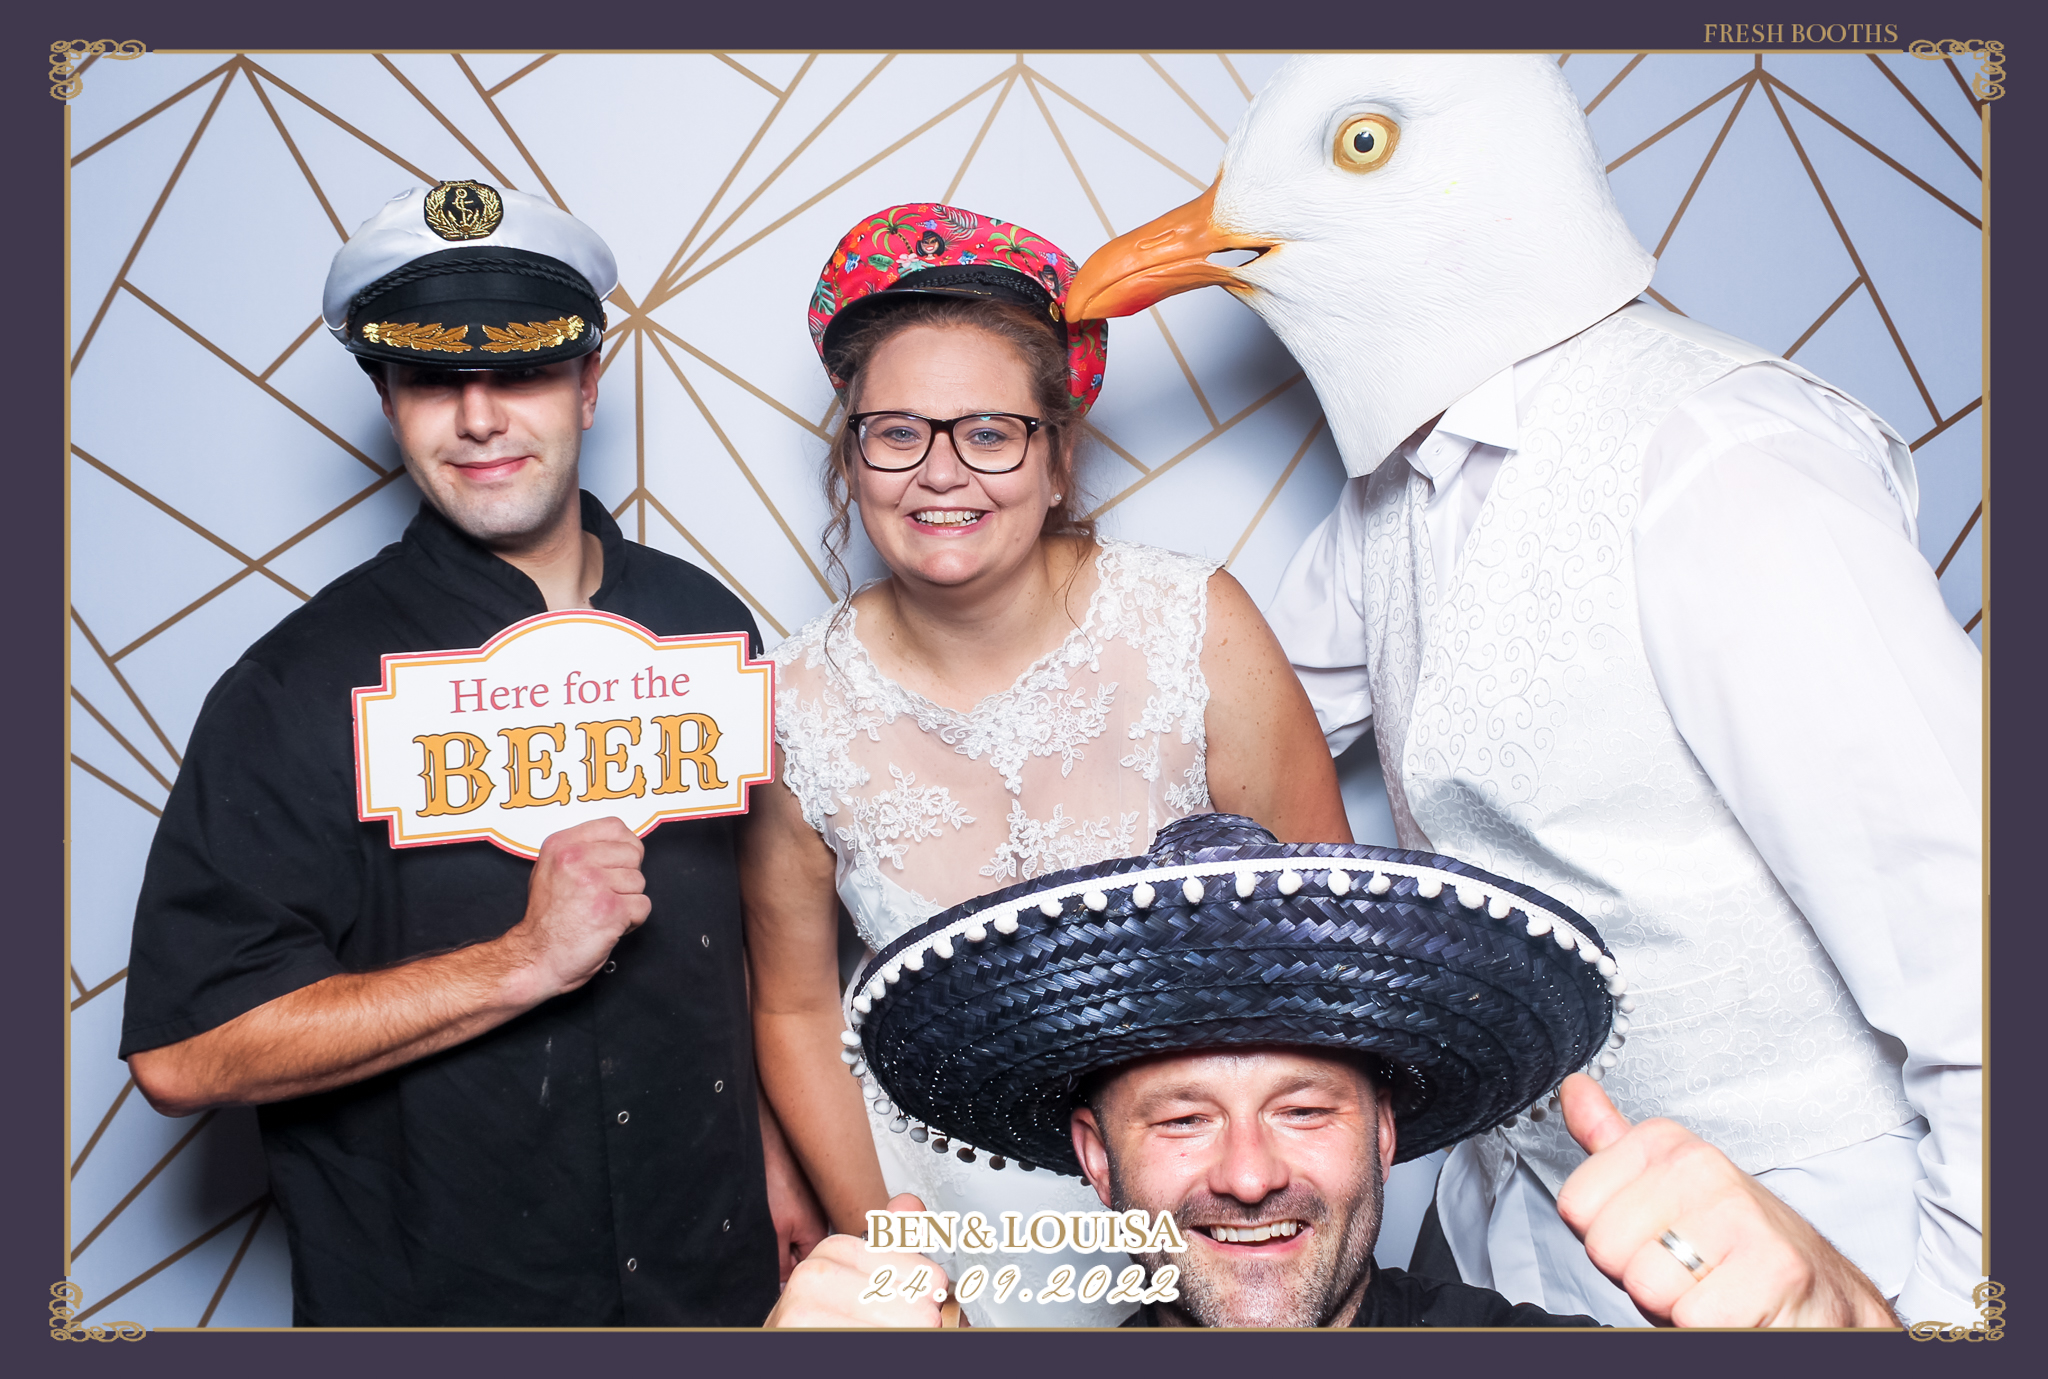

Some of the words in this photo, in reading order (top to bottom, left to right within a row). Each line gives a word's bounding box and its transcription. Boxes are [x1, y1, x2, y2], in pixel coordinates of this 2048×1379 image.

[449, 678, 550, 714] Here
[563, 670, 619, 706] for
[631, 665, 691, 700] the
[411, 712, 729, 818] BEER
